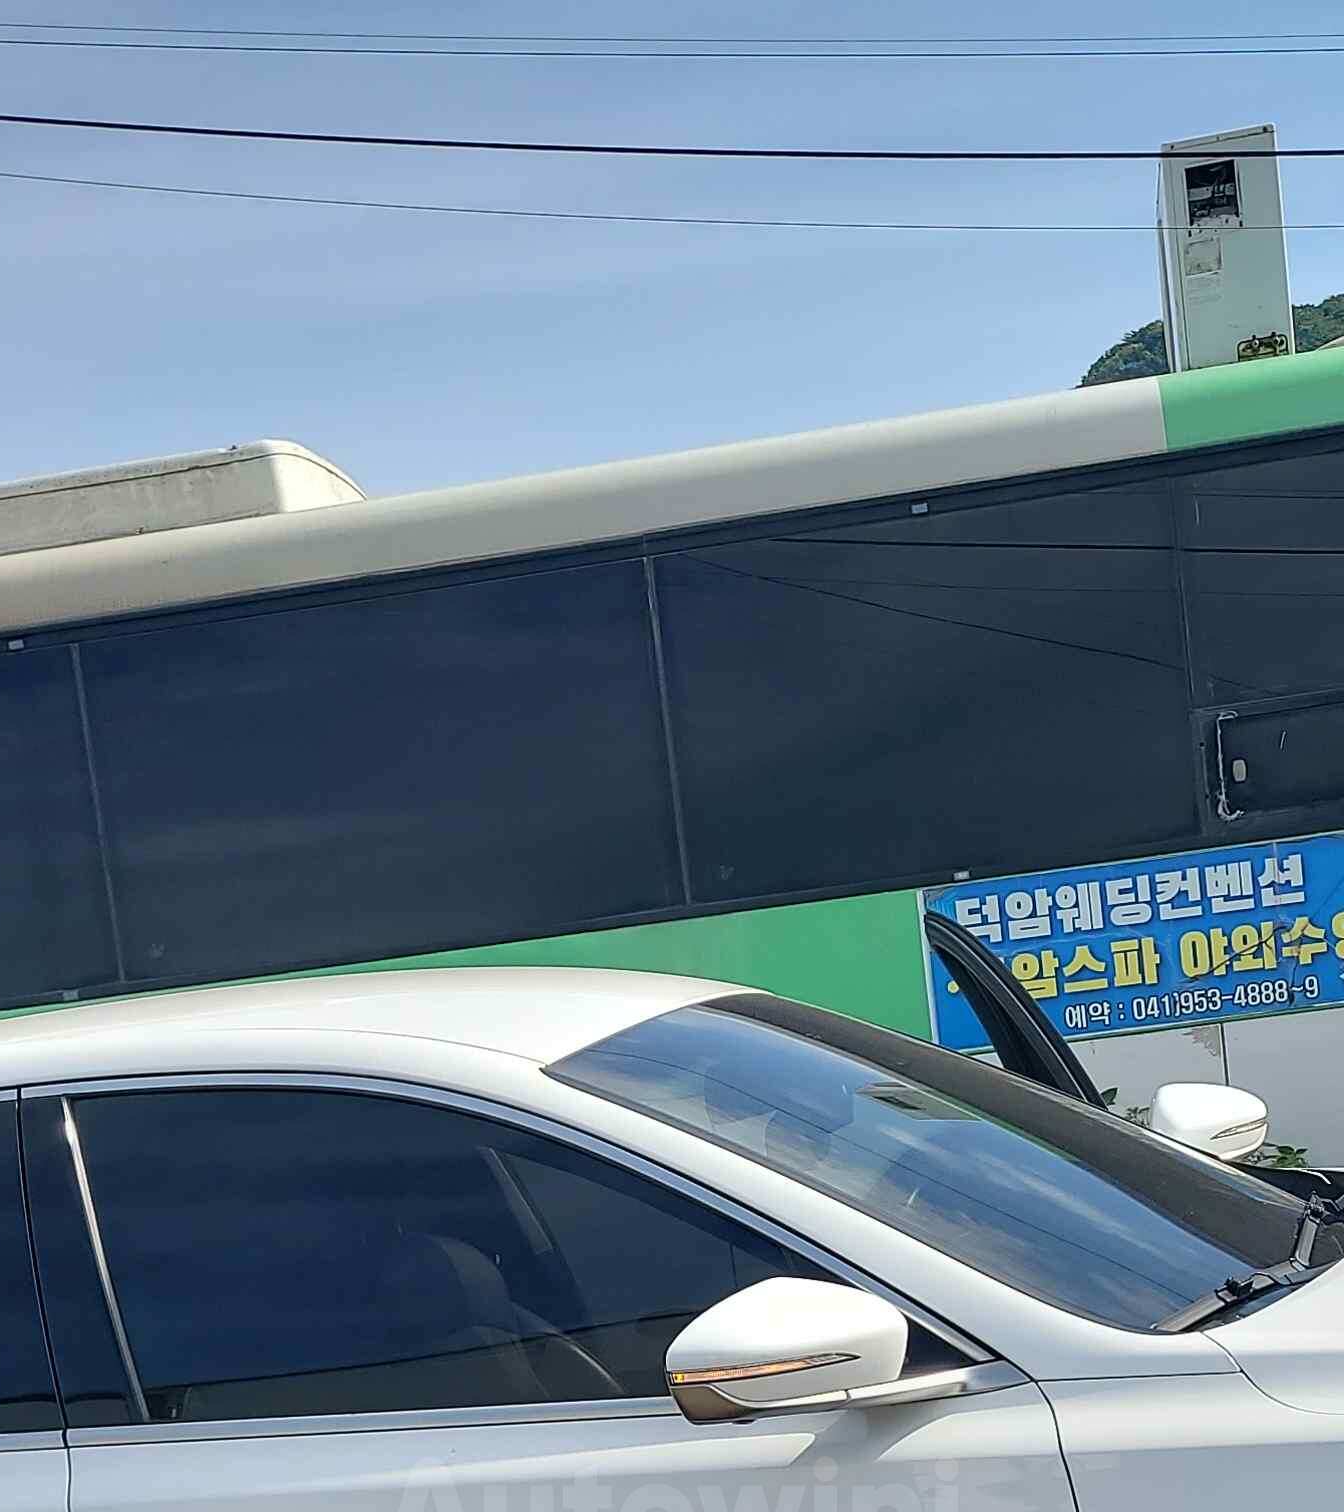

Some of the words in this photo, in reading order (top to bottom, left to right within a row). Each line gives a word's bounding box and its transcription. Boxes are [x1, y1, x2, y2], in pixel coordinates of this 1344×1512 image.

[955, 854, 1306, 944] 덕암웨딩컨벤션
[1001, 936, 1160, 1001] 암스파
[1064, 1000, 1111, 1029] 예약
